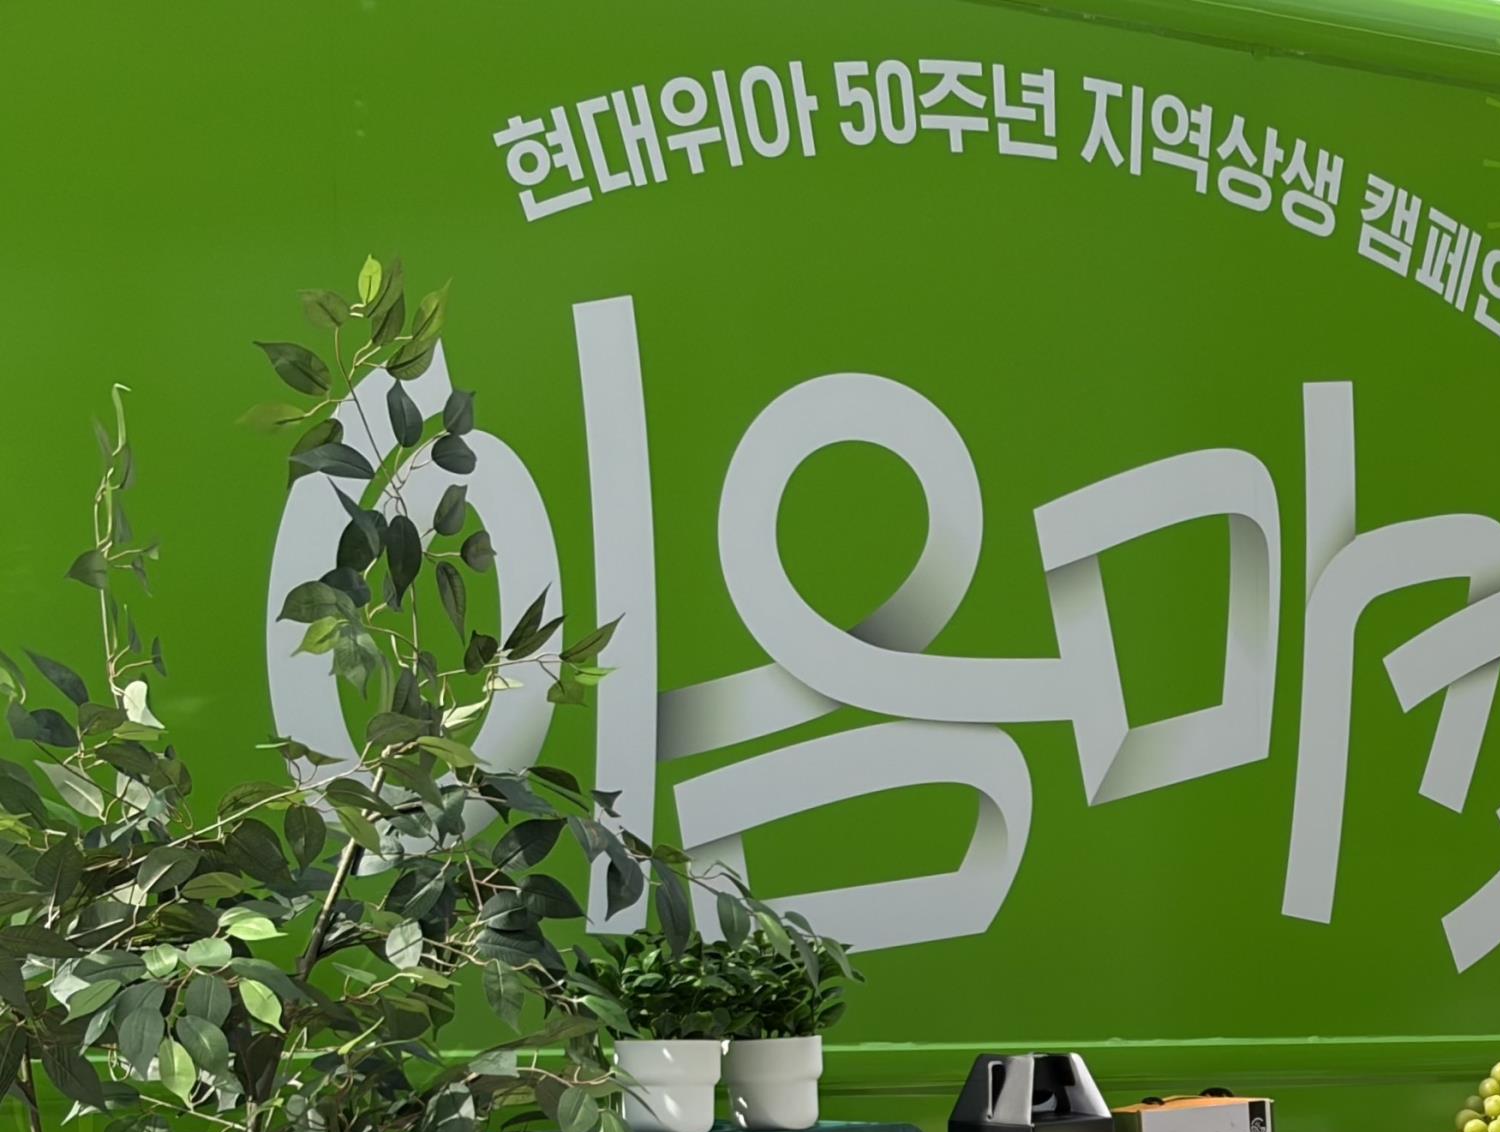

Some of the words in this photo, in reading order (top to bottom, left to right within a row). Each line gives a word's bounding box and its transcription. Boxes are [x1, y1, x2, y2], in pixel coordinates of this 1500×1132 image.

[493, 61, 820, 222] 현대위아
[836, 59, 1059, 161] 50주년
[1081, 76, 1344, 238] 지역상생
